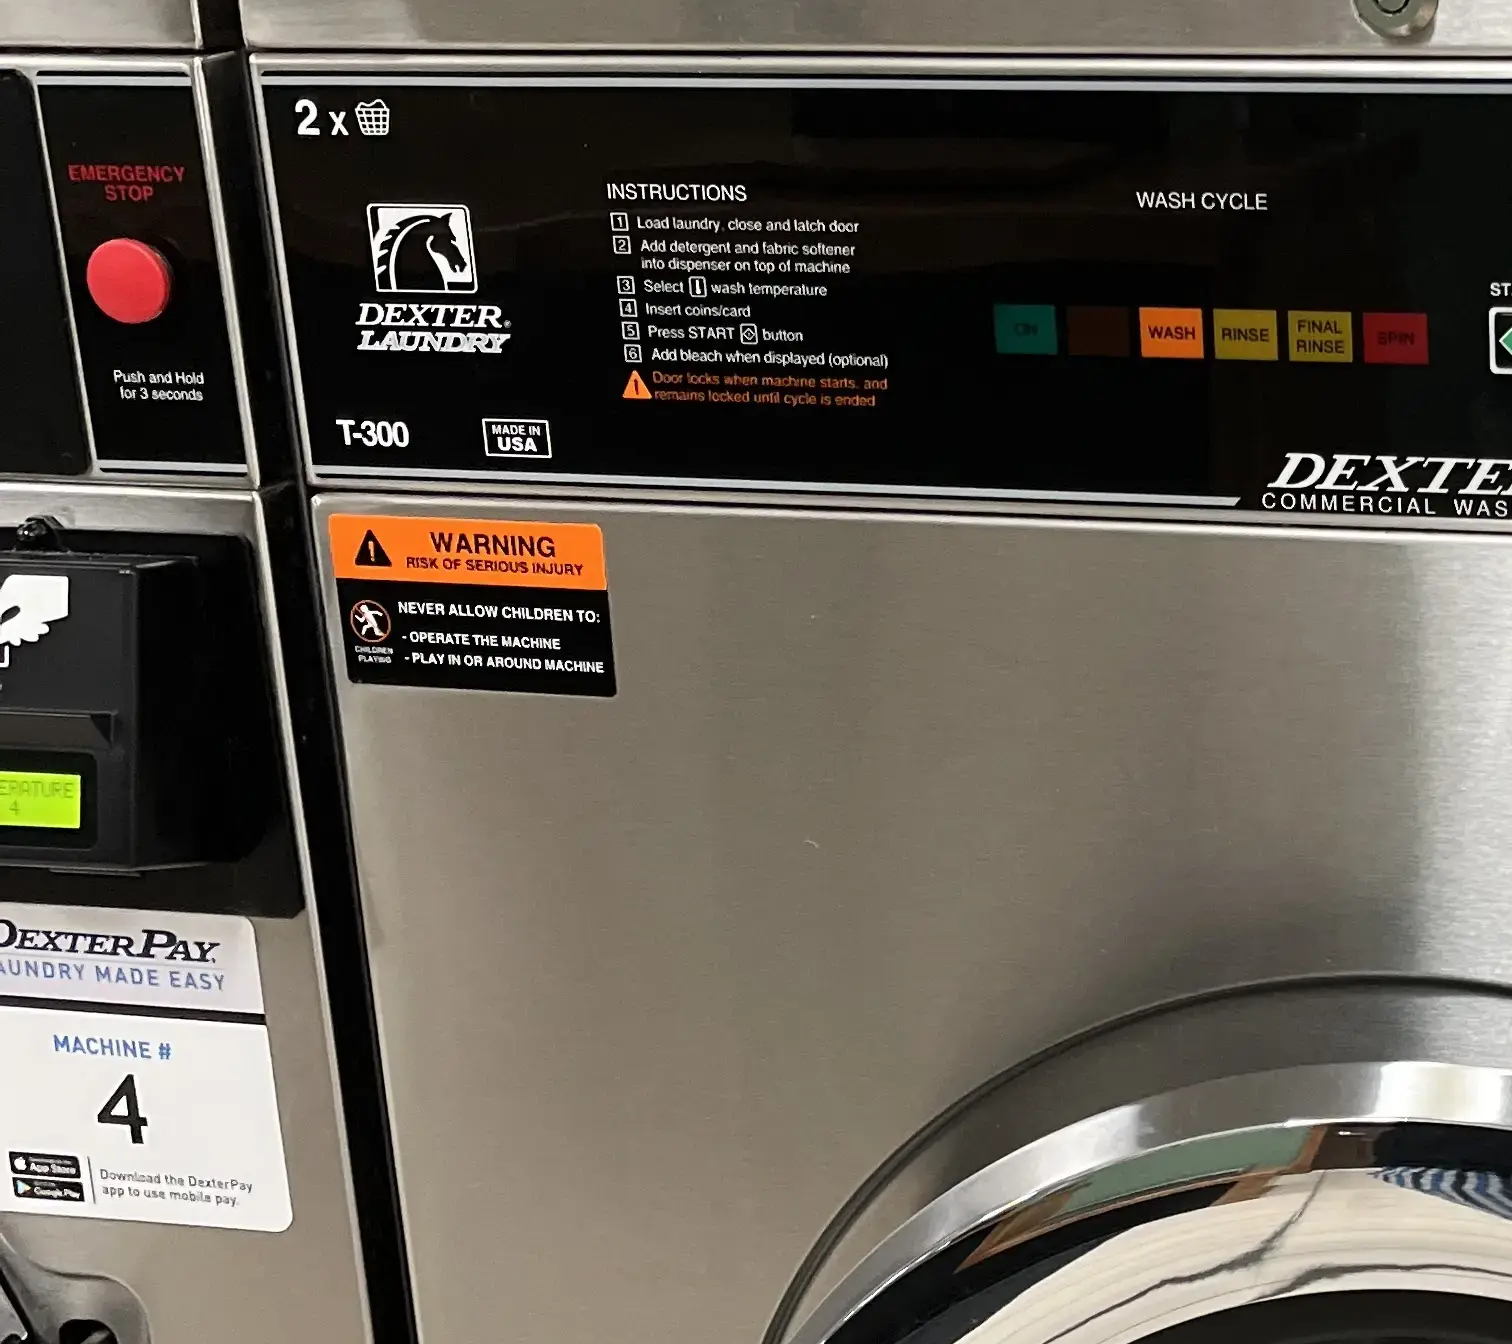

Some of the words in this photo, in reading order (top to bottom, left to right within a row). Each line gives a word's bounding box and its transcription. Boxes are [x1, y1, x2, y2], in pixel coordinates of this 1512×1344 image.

[295, 99, 320, 136] 2
[68, 165, 185, 181] EMERGENCY
[105, 185, 154, 201] STOP
[607, 183, 747, 201] INSTRUCTIONS
[1136, 191, 1196, 209] WASH
[1201, 192, 1268, 210] CYCLE
[637, 216, 669, 229] Load
[673, 217, 725, 233] laundry,
[728, 218, 762, 231] close
[766, 218, 791, 231] and
[794, 218, 825, 232] latch
[829, 220, 859, 232] door
[641, 240, 667, 252] Add
[670, 242, 730, 256] detergent
[735, 242, 759, 254] and
[763, 242, 798, 255] fabric
[802, 244, 855, 256] softener
[644, 280, 684, 293] Select
[711, 283, 745, 295] wash
[749, 283, 827, 298] temperature
[355, 303, 502, 328] DEXTER
[646, 303, 682, 315] Insert
[685, 304, 750, 317] coins/card
[648, 326, 684, 338] Press
[688, 327, 735, 339] START
[762, 328, 803, 342] button
[1148, 325, 1196, 341] WASH
[1221, 327, 1268, 342] RINSE
[1298, 320, 1342, 334] FINAL
[357, 331, 511, 353] LAUNDRY
[1296, 339, 1344, 354] RINSE
[652, 348, 677, 361] Add
[680, 349, 726, 362] bleach
[728, 352, 761, 363] when
[764, 351, 825, 368] displayed
[829, 353, 888, 368] (optional)
[335, 419, 409, 447] T-300
[492, 424, 524, 436] MADE
[528, 426, 540, 436] IN
[498, 438, 537, 452] USA
[1261, 493, 1436, 515] COMMERCIAL
[430, 532, 556, 557] WARNING
[406, 557, 438, 570] RISK
[442, 558, 460, 570] OF
[465, 560, 528, 573] SERIOUS
[532, 562, 584, 576] INJURY
[398, 602, 444, 616] NEVER
[449, 604, 498, 618] ALLOW
[502, 606, 573, 622] CHILDREN
[576, 610, 600, 623] TO:
[410, 632, 470, 646] OPERATE
[472, 634, 496, 646] THE
[502, 636, 561, 650] MACHINE
[412, 653, 444, 664] PLAY
[448, 654, 460, 666] IN
[464, 655, 482, 667] OR
[486, 656, 542, 670] AROUND
[545, 658, 604, 673] MACHINE
[9, 800, 19, 815] 4
[96, 965, 157, 986] MADE
[170, 971, 224, 990] EASY
[53, 1034, 151, 1059] MACHINE
[159, 1042, 171, 1060] #
[97, 1073, 148, 1144] 4
